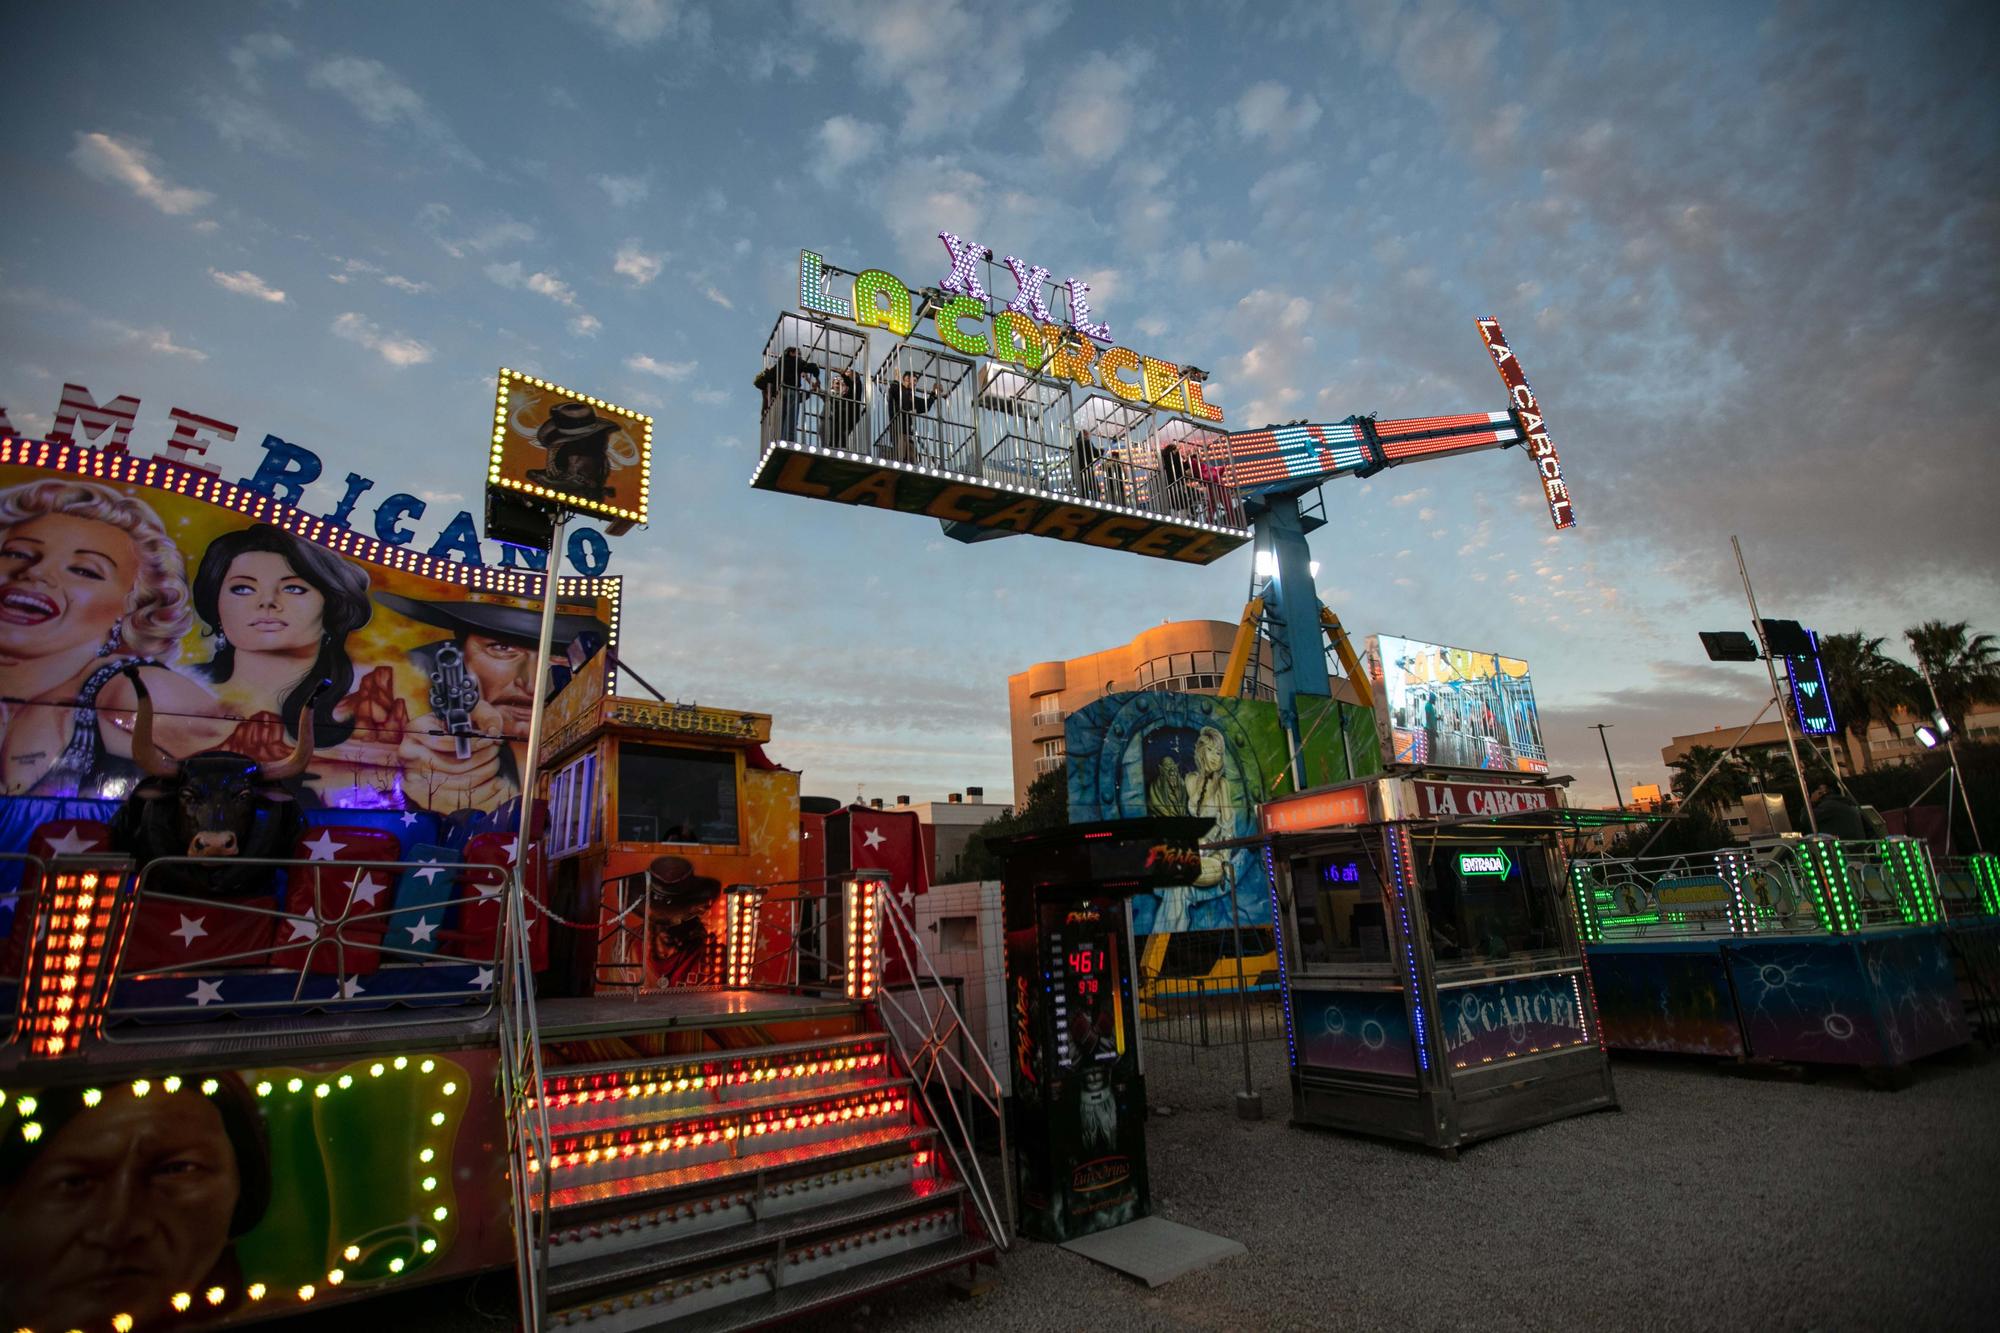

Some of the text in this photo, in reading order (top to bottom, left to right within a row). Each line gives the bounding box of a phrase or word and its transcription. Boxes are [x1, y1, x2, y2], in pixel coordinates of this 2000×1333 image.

[938, 231, 1113, 343] XXL
[800, 248, 1224, 423] LA CARCEL
[1478, 320, 1571, 525] LA CARCEL
[775, 454, 1218, 565] LA CARCEL
[617, 703, 760, 737] TAQUILLA
[1424, 785, 1547, 816] LA CARCEL
[1462, 857, 1503, 872] ENTRADA
[1068, 950, 1105, 974] 461
